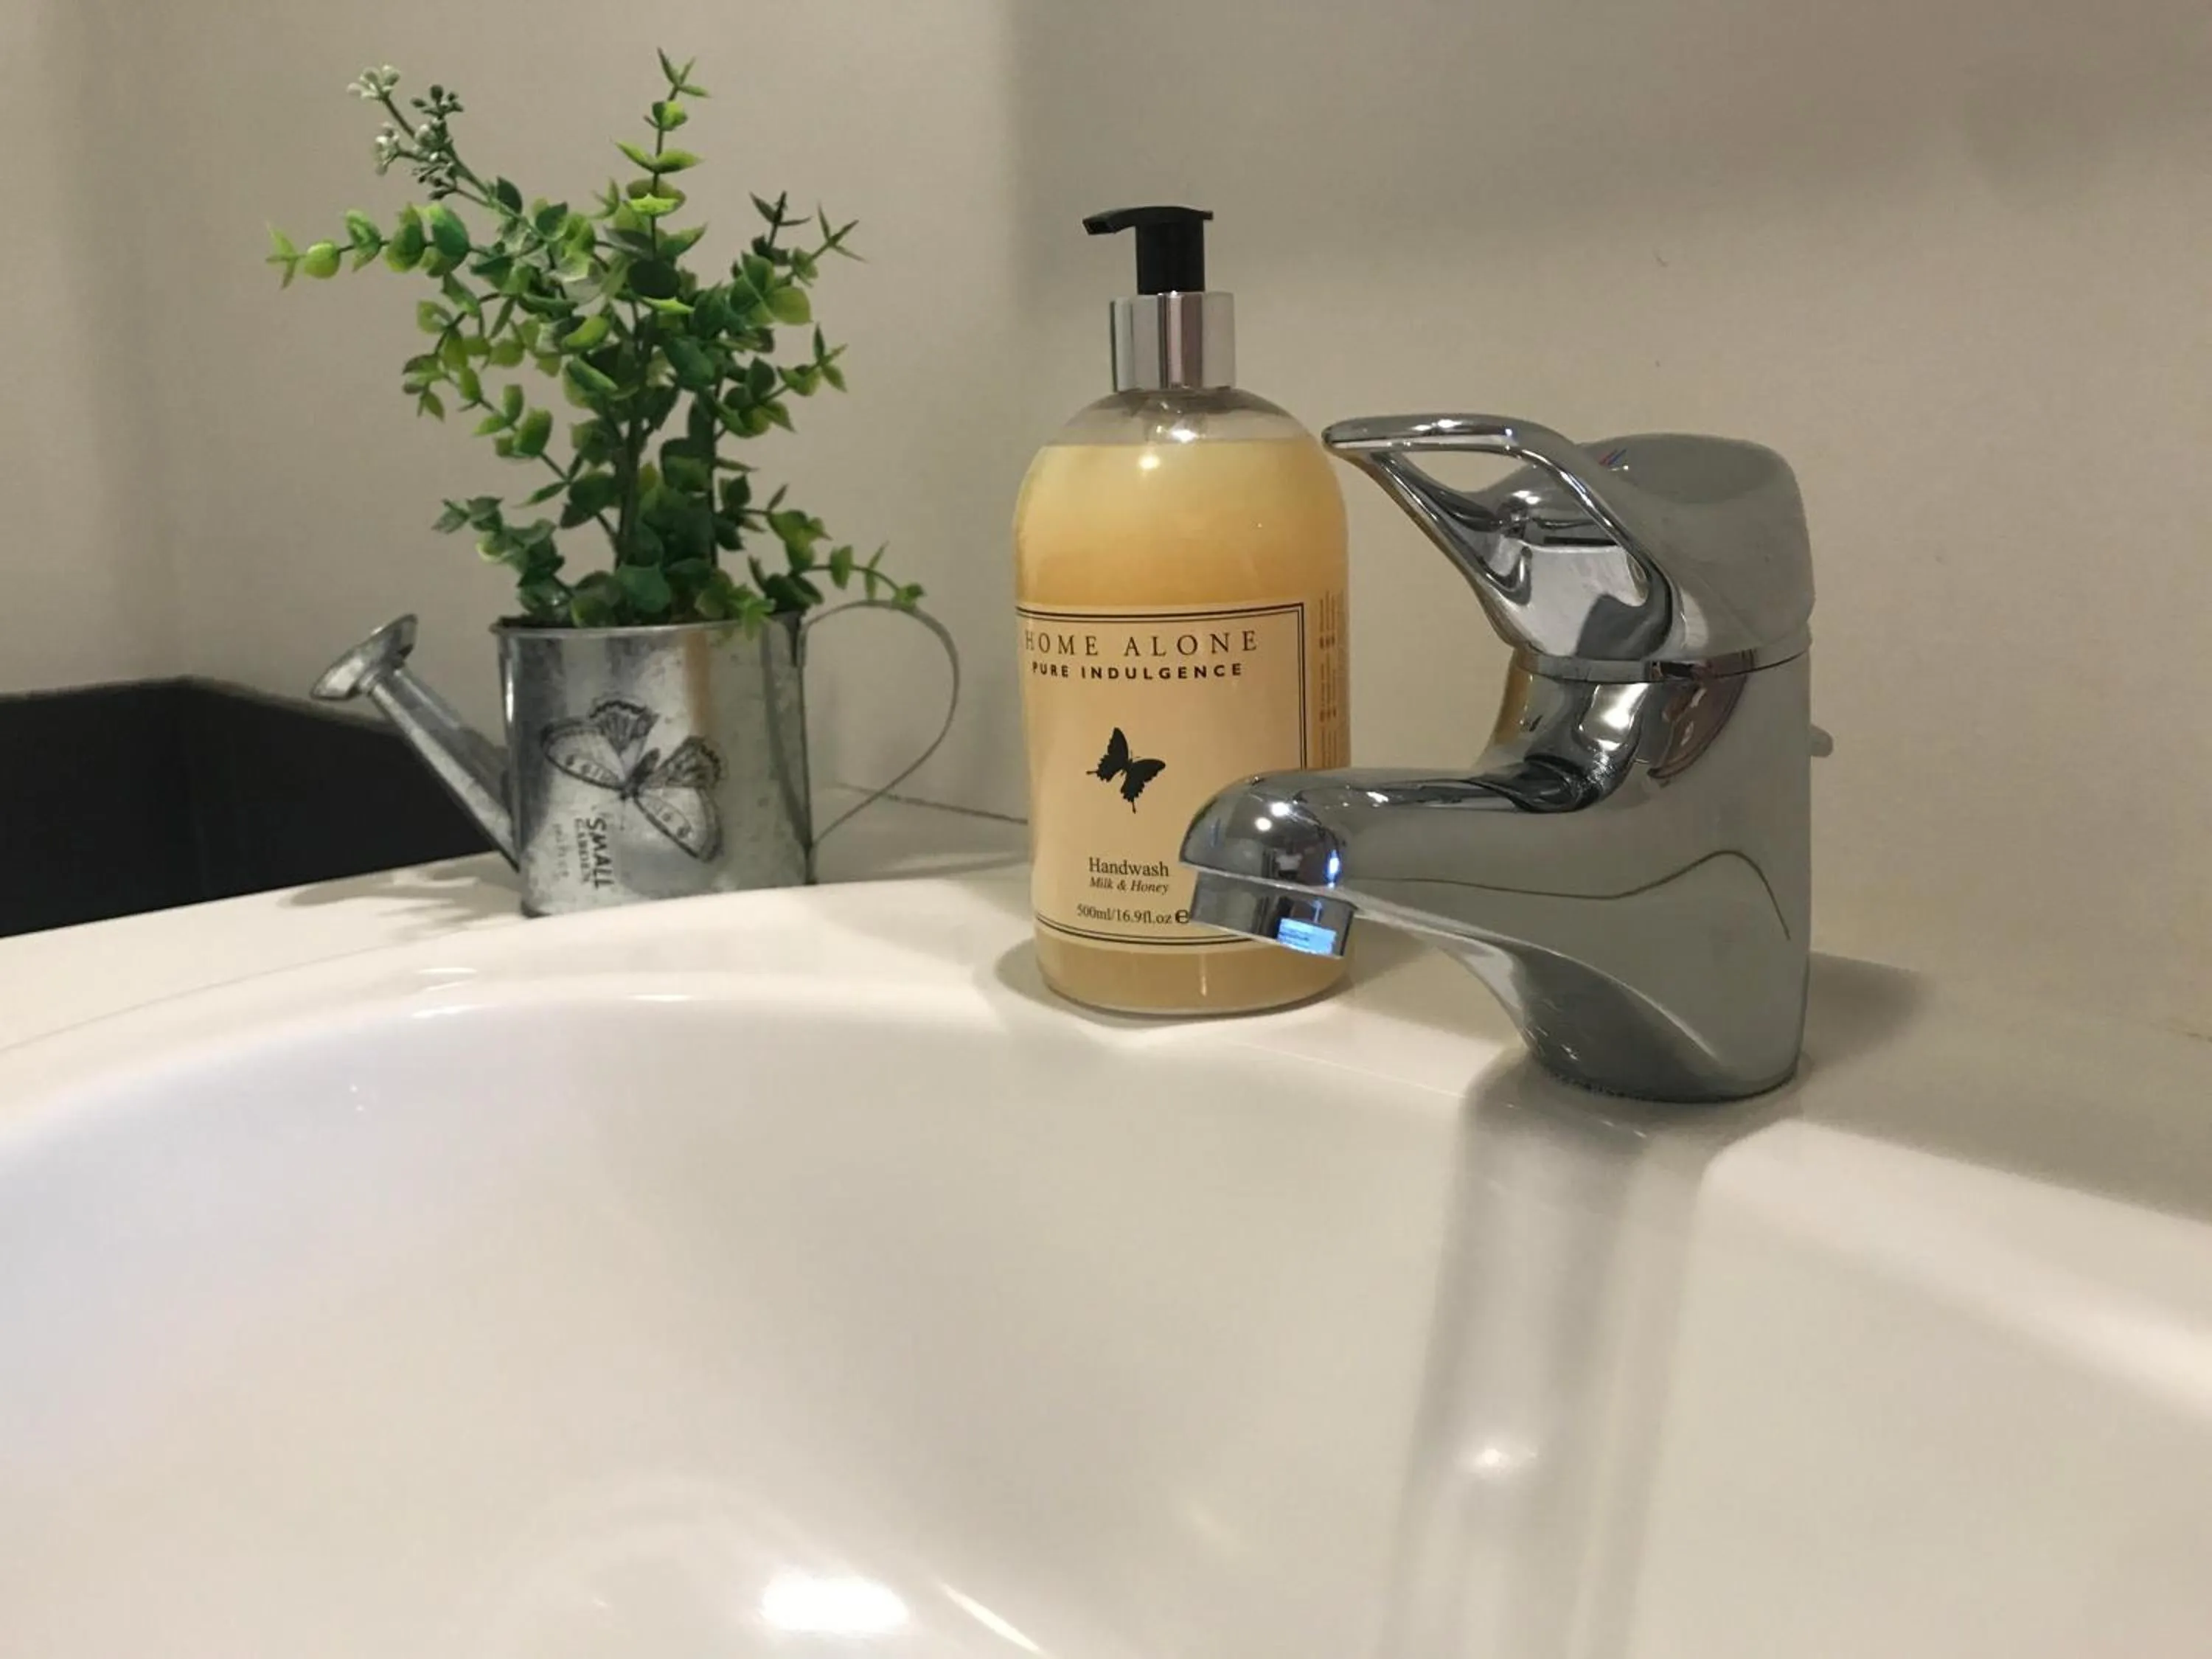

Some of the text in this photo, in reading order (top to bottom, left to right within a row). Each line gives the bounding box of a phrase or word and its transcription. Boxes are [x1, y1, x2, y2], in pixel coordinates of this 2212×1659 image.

[1025, 630, 1257, 656] HOME ALONE
[1032, 661, 1242, 679] PURE INDULGENCE
[586, 818, 614, 890] SMALL
[1089, 857, 1169, 877] Handwash
[1089, 877, 1169, 895] Milk & Honey
